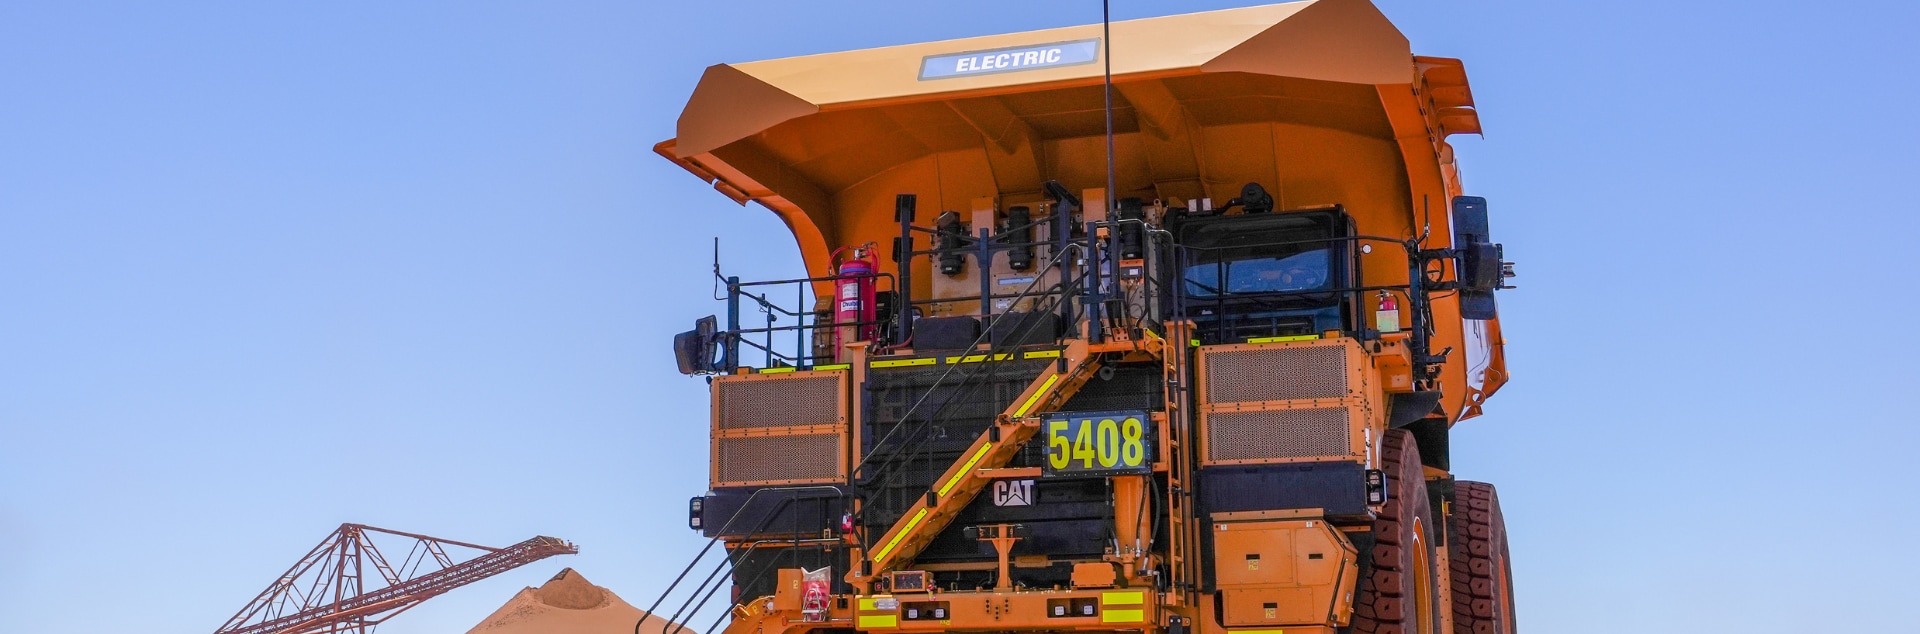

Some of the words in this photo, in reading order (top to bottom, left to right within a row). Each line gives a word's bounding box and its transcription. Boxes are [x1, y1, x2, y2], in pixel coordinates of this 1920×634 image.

[956, 48, 1061, 72] ELECTRIC
[1049, 418, 1143, 470] 5408
[993, 480, 1034, 506] CAT
